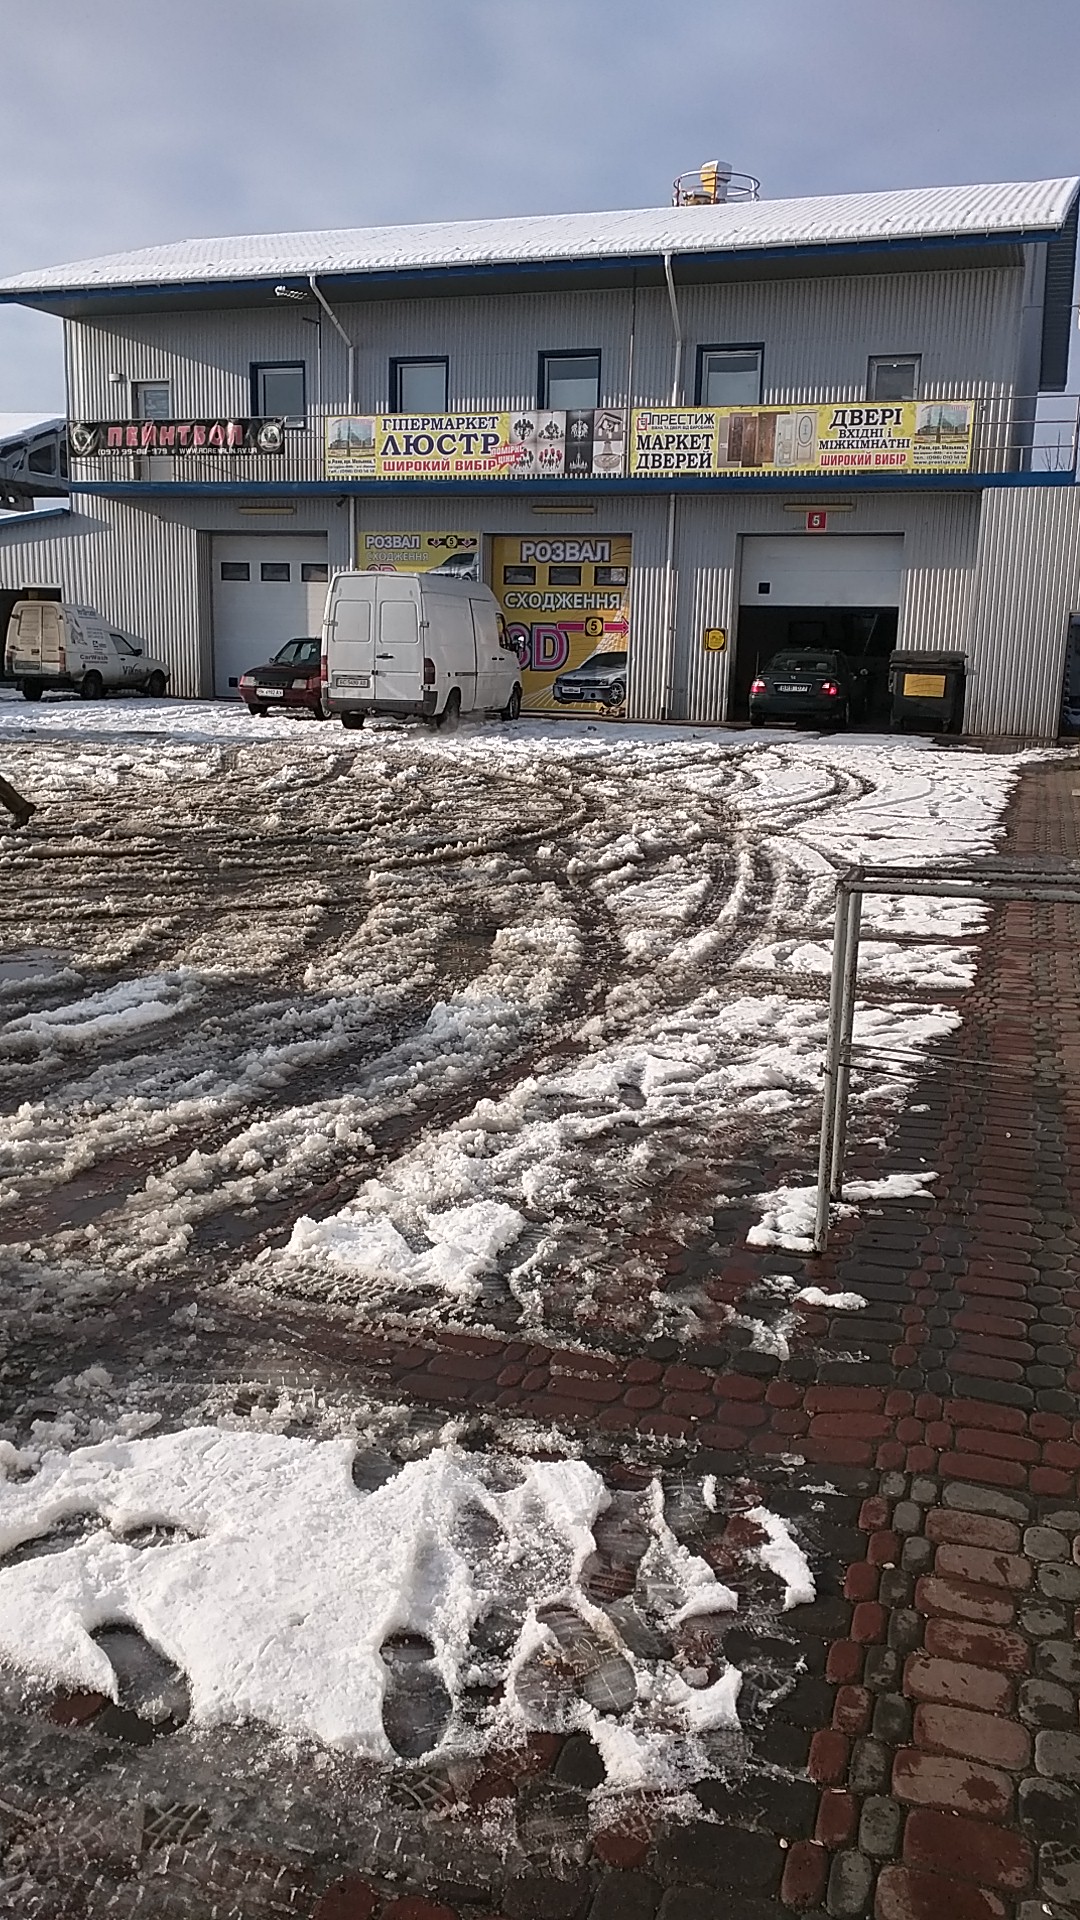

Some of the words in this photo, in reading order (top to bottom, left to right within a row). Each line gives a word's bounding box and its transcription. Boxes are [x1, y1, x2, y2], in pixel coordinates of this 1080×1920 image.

[382, 417, 499, 431] ГІПЕРМАРКЕТ
[652, 413, 715, 425] ПРЕСТИЖ
[829, 408, 902, 429] ДВЕРІ
[107, 422, 243, 447] ПЕЙНТБОЛ
[838, 428, 884, 439] ВХІДНІ
[380, 434, 500, 456] ЛЮСТР
[636, 434, 714, 450] МАРКЕТ
[819, 438, 911, 450] МІЖКІМНАТНІ
[97, 448, 120, 456] (097)
[383, 458, 450, 472] ШИРОКИЙ
[455, 459, 497, 471] ВИБІР
[636, 450, 713, 470] ДВЕРЕЙ
[820, 453, 872, 466] ШИРОКИЙ
[874, 454, 906, 465] ВИБІР
[812, 515, 820, 526] 5
[365, 535, 421, 549] РОЗВАЛ
[449, 537, 454, 545] 5
[367, 552, 429, 561] СХОДЖЕННЯ
[521, 540, 611, 563] РОЗВАЛ
[504, 592, 622, 611] СХОДЖЕННЯ
[590, 620, 598, 631] 5
